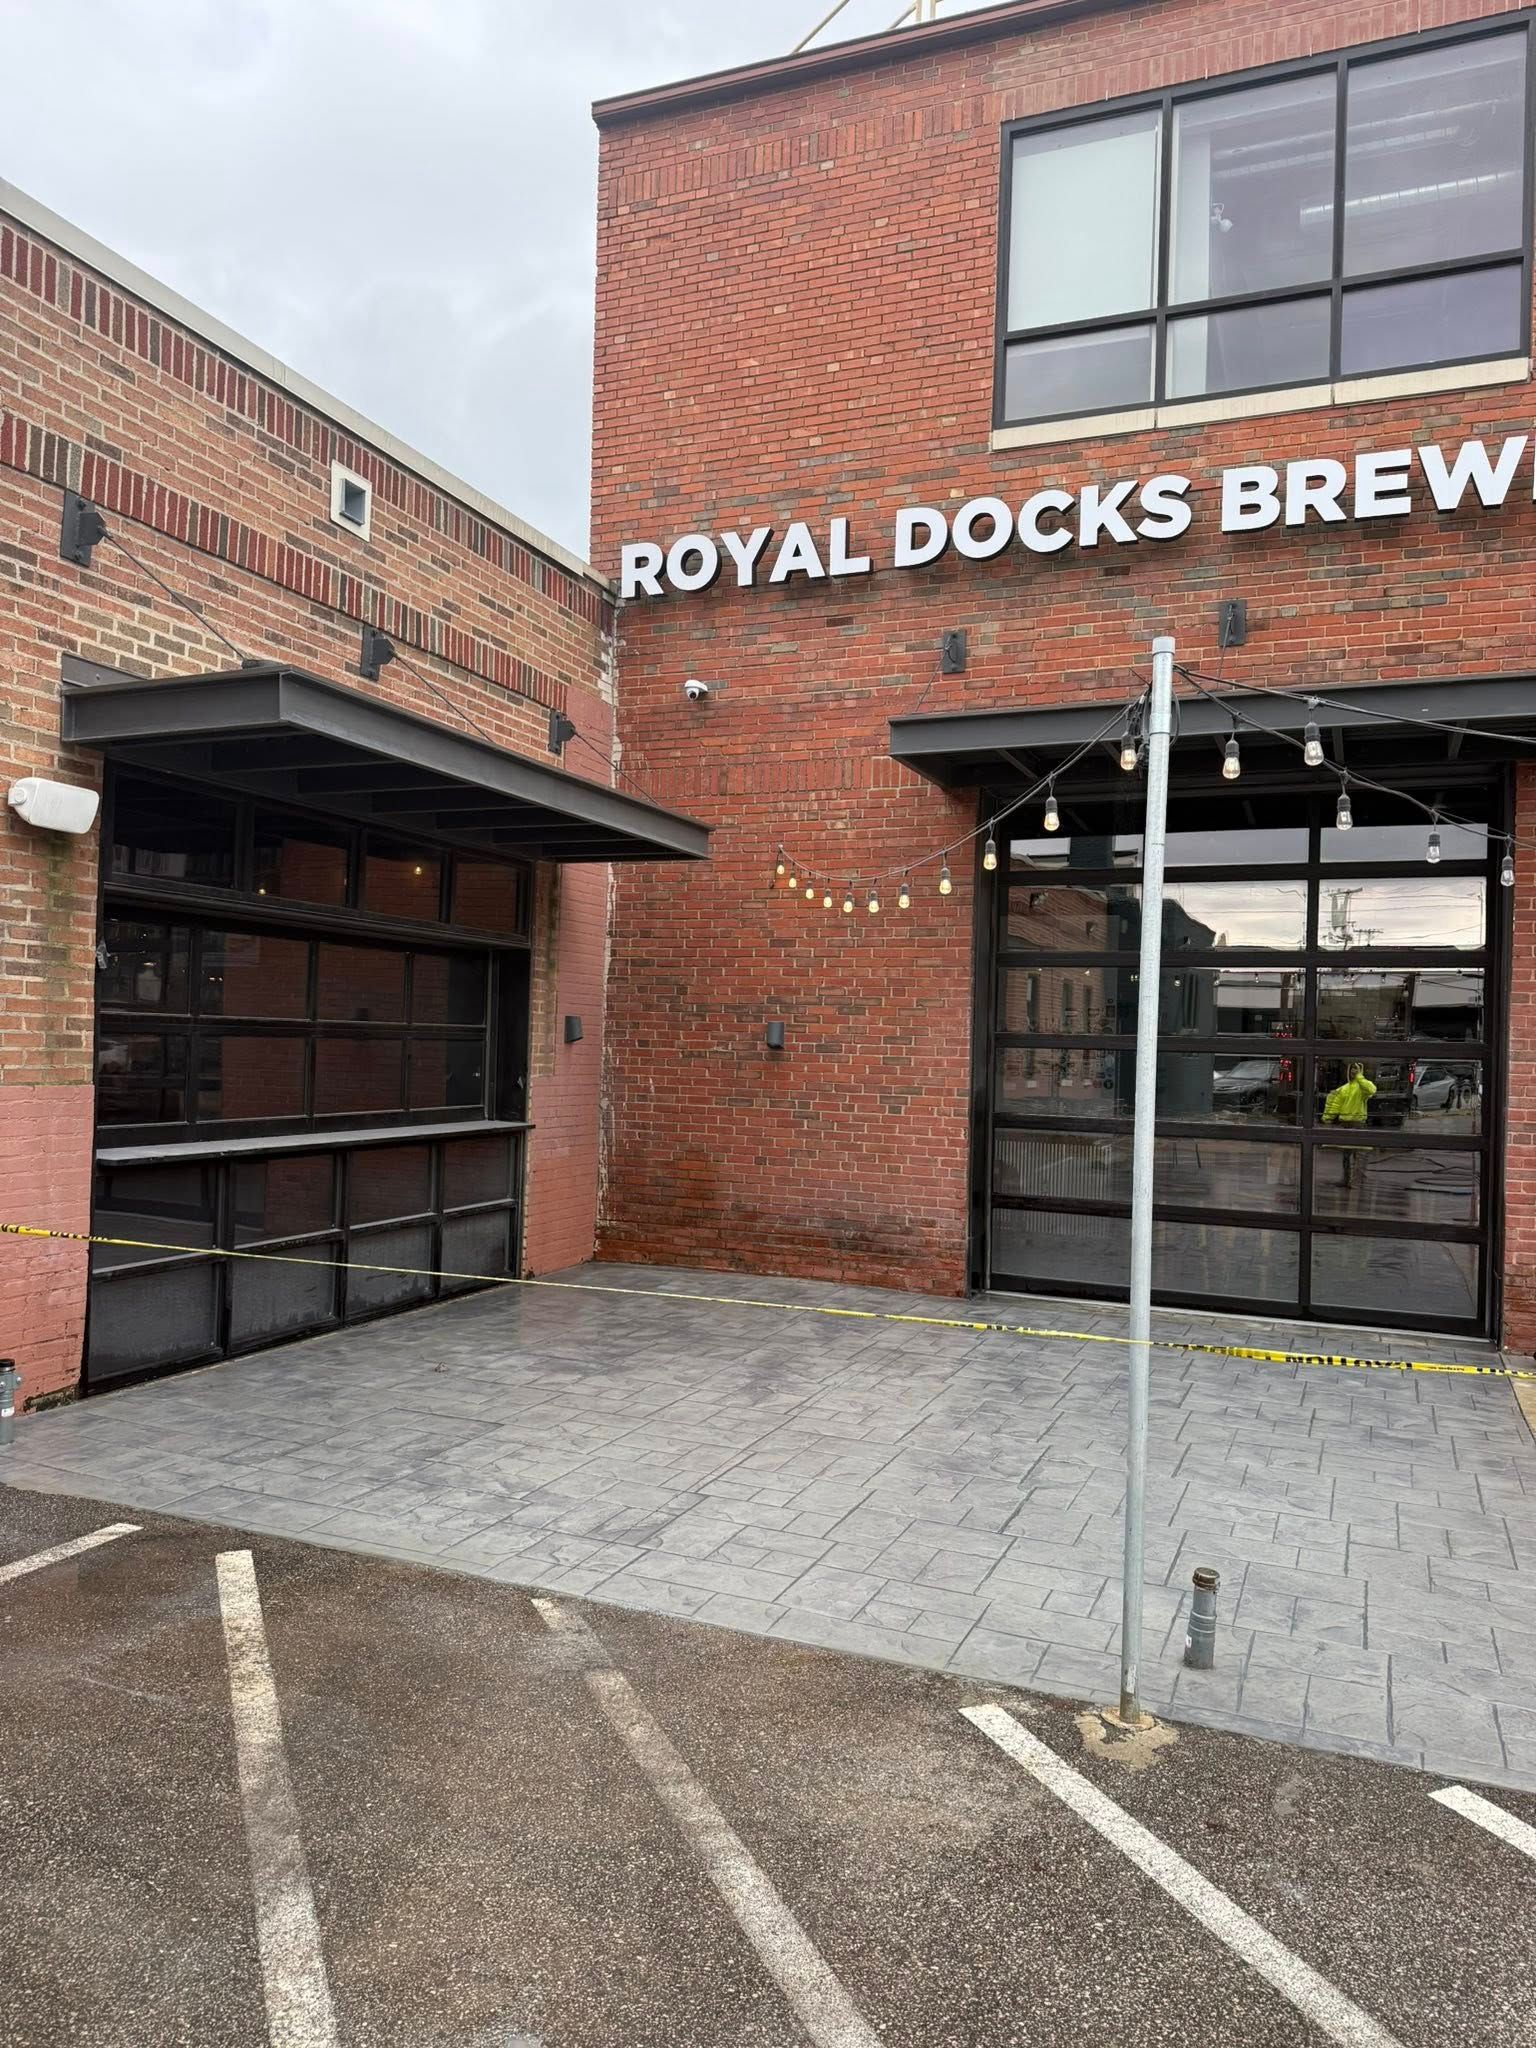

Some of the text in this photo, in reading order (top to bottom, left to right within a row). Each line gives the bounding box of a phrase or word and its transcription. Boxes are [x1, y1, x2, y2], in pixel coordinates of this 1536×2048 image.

[620, 435, 1536, 599] ROYAL DOCKS BREW
